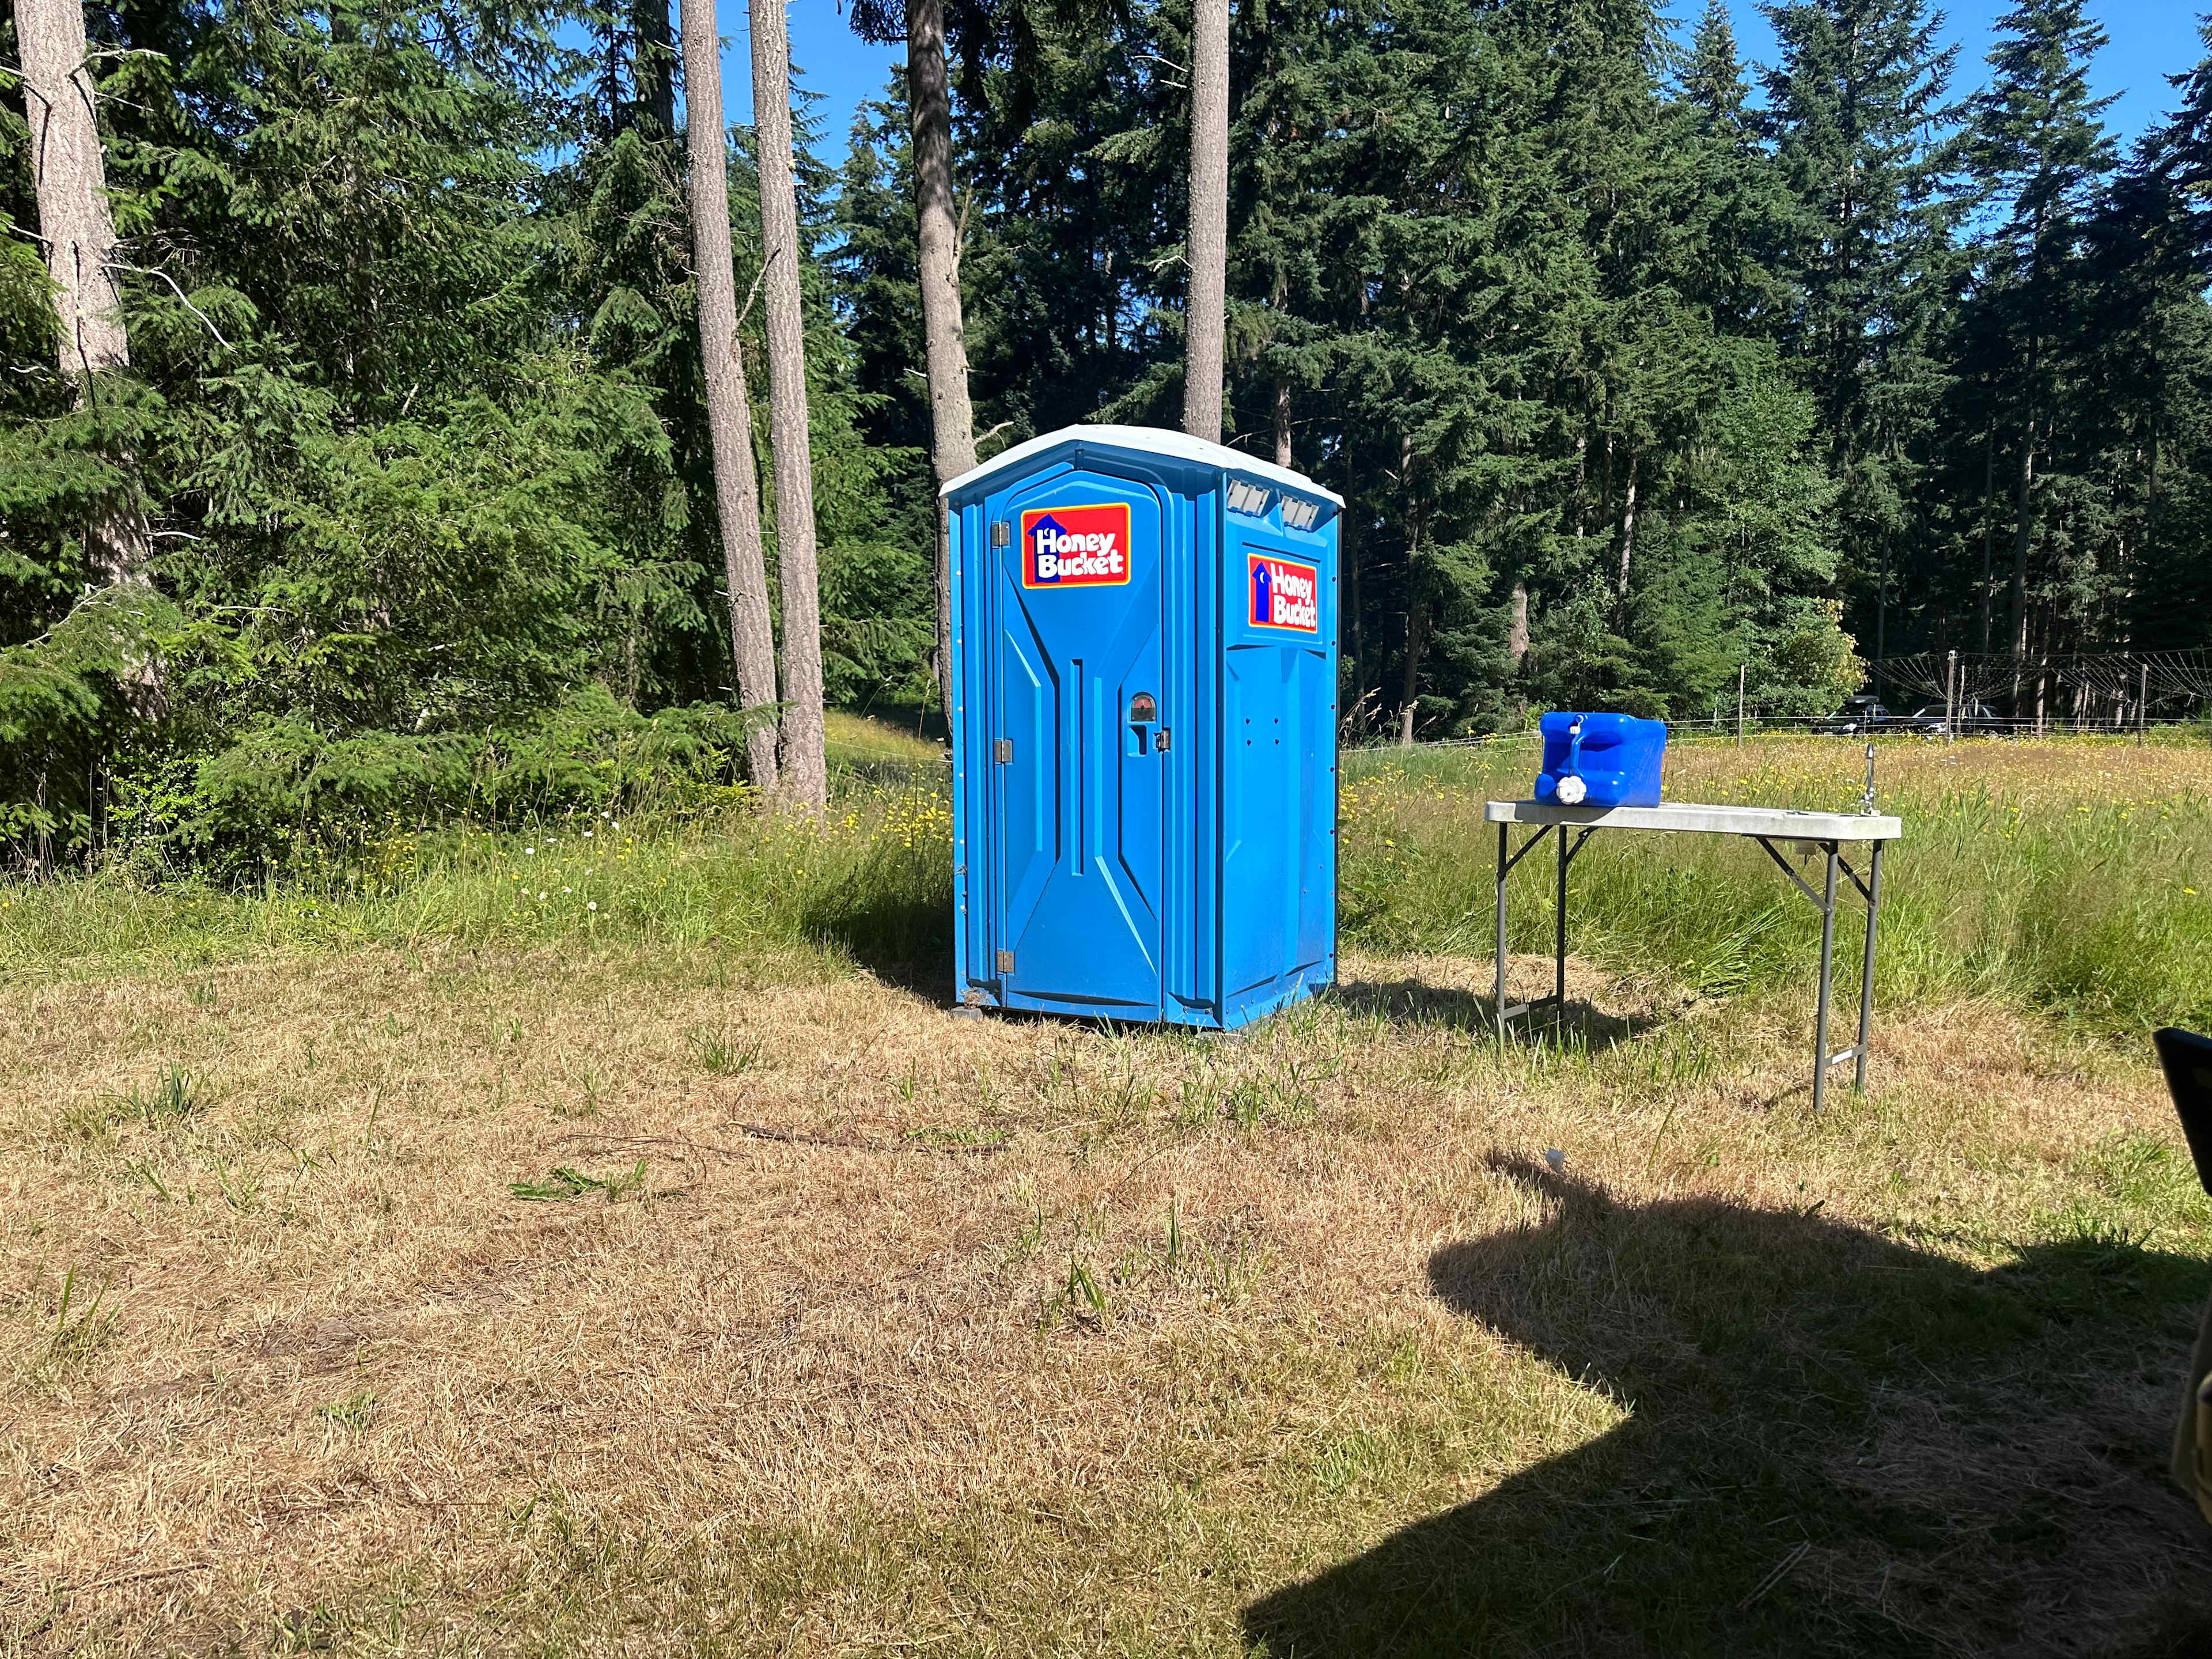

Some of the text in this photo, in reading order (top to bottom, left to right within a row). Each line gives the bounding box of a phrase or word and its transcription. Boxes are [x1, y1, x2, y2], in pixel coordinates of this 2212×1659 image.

[1037, 528, 1116, 556] Honey
[1038, 549, 1123, 578] Bucket
[1270, 563, 1312, 605] Honey
[1274, 594, 1316, 627] Bucket
